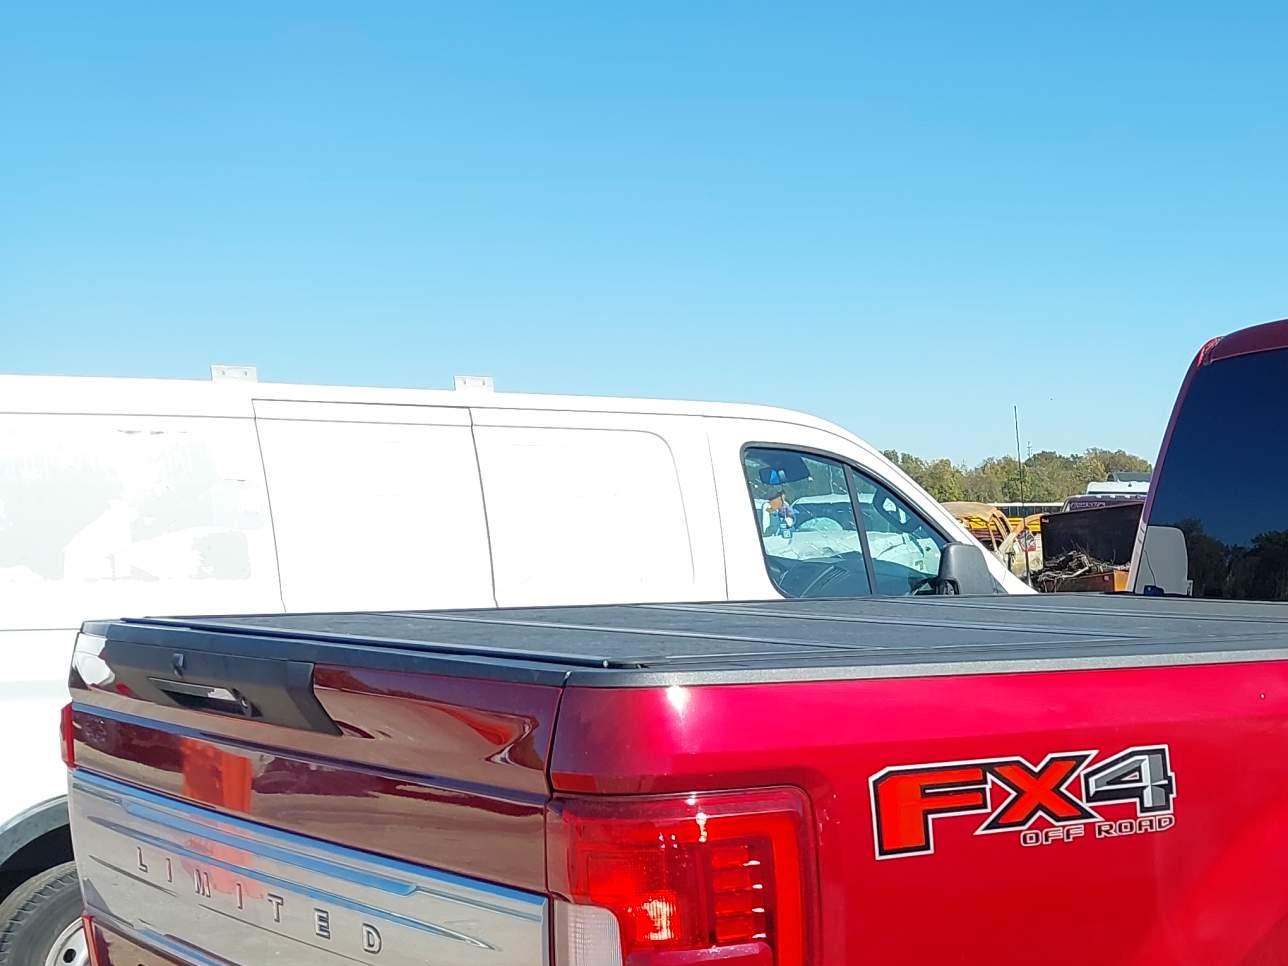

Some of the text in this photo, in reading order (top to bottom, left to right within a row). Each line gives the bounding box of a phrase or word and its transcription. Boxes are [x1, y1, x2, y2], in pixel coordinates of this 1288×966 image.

[868, 744, 1176, 860] FX4
[1020, 815, 1175, 846] OFF ROAD
[137, 845, 383, 955] LIMITED
